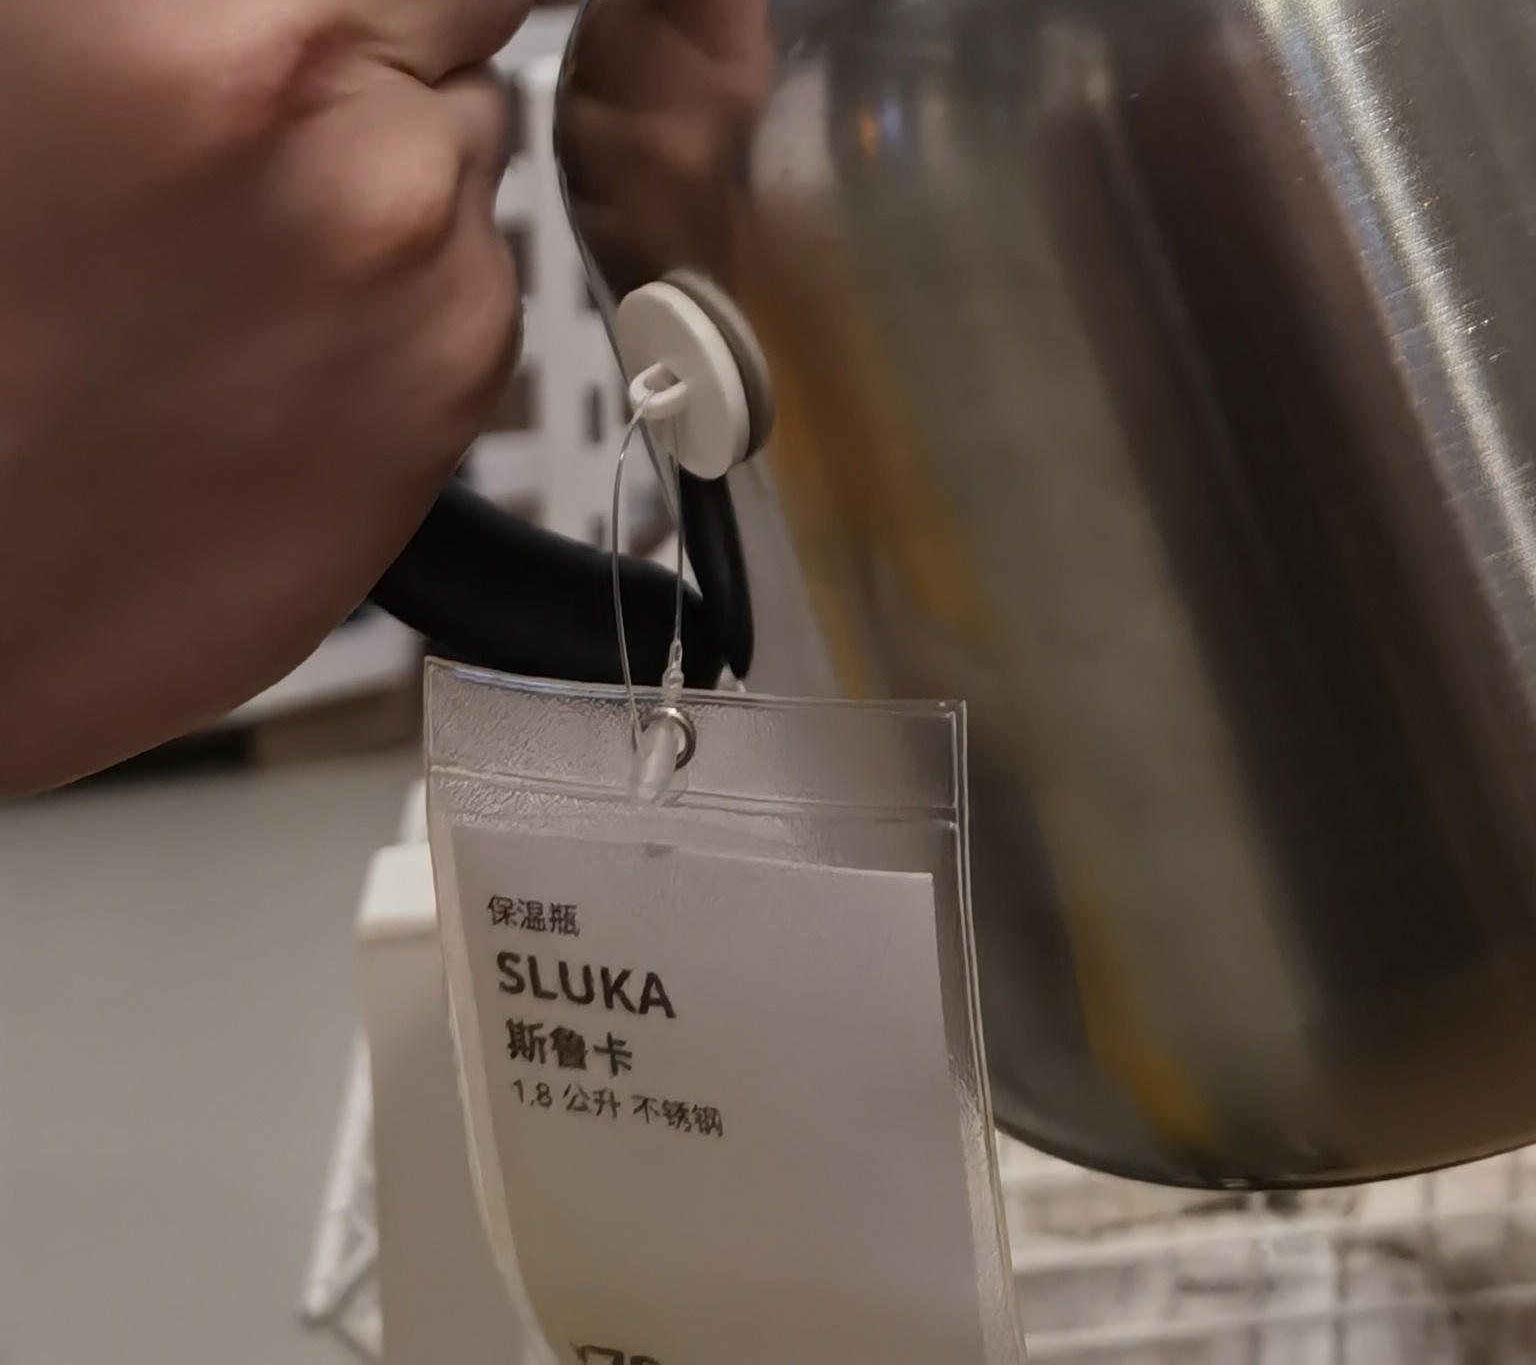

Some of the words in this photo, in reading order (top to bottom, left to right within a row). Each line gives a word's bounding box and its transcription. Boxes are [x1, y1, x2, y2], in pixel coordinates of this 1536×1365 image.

[487, 895, 580, 937] 保温瓶
[496, 951, 677, 1019] SLUKA
[563, 1083, 621, 1118] 公升
